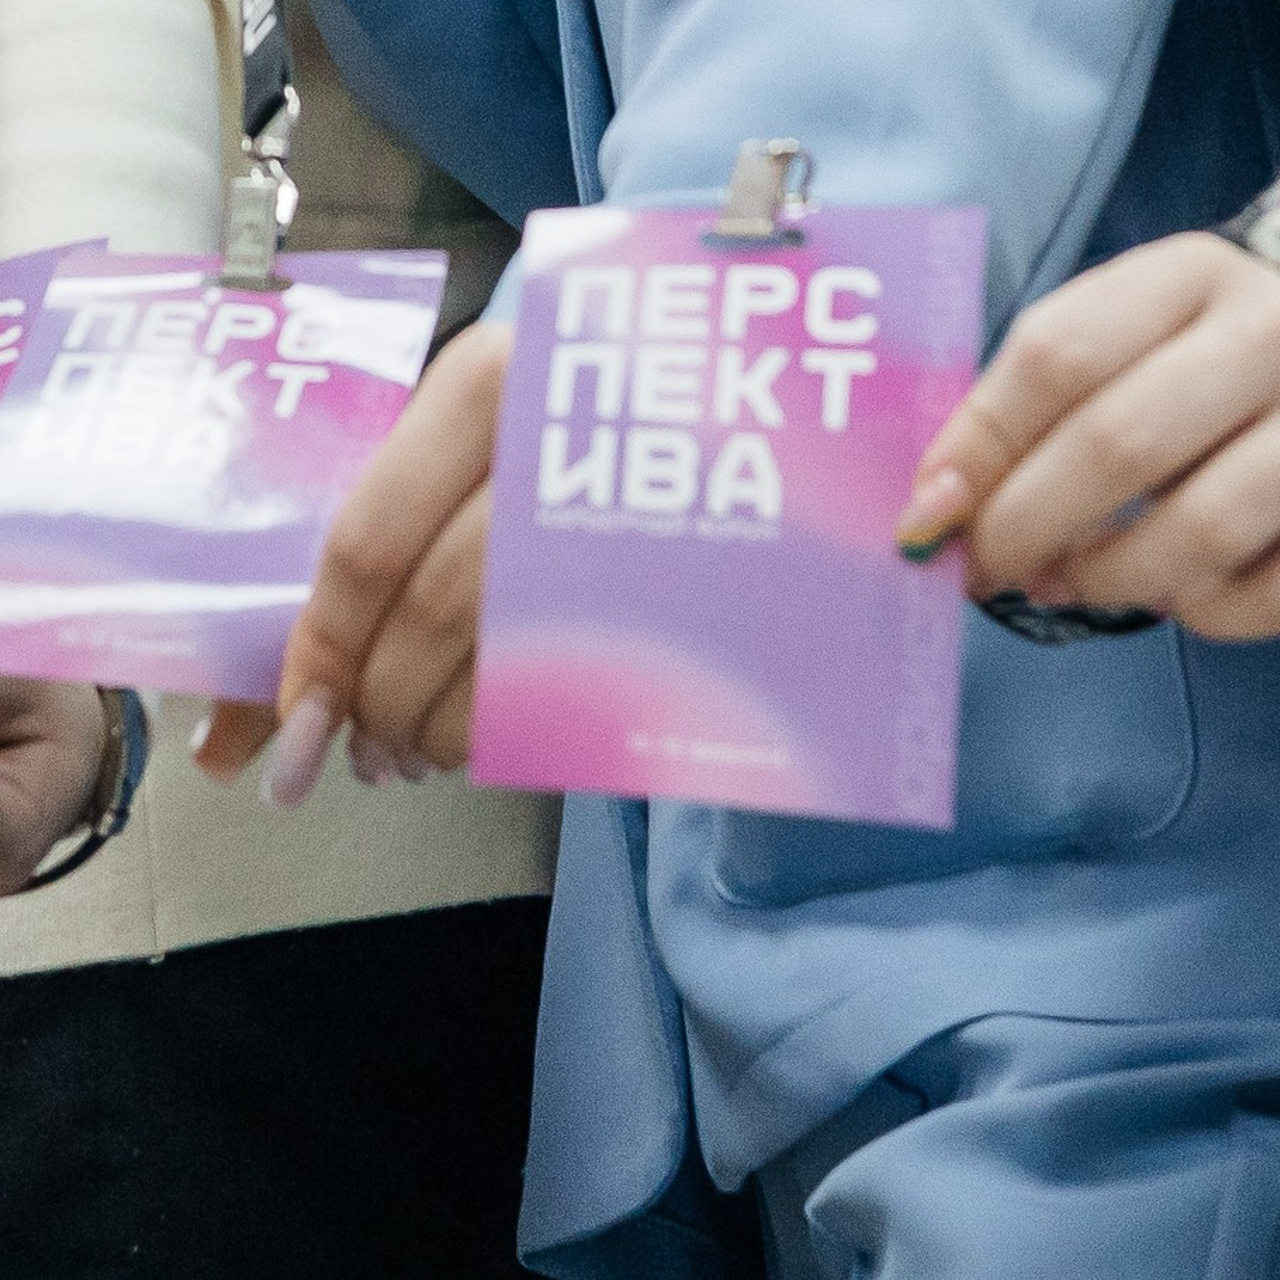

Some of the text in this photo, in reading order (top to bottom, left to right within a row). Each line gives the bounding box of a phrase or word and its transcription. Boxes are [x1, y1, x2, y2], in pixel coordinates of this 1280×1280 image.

[65, 299, 336, 363] ПЕРС
[555, 263, 883, 344] ПЕРС
[39, 351, 330, 420] ПЕКТ
[545, 341, 878, 433] ПЕКТ
[536, 422, 784, 520] ИВА
